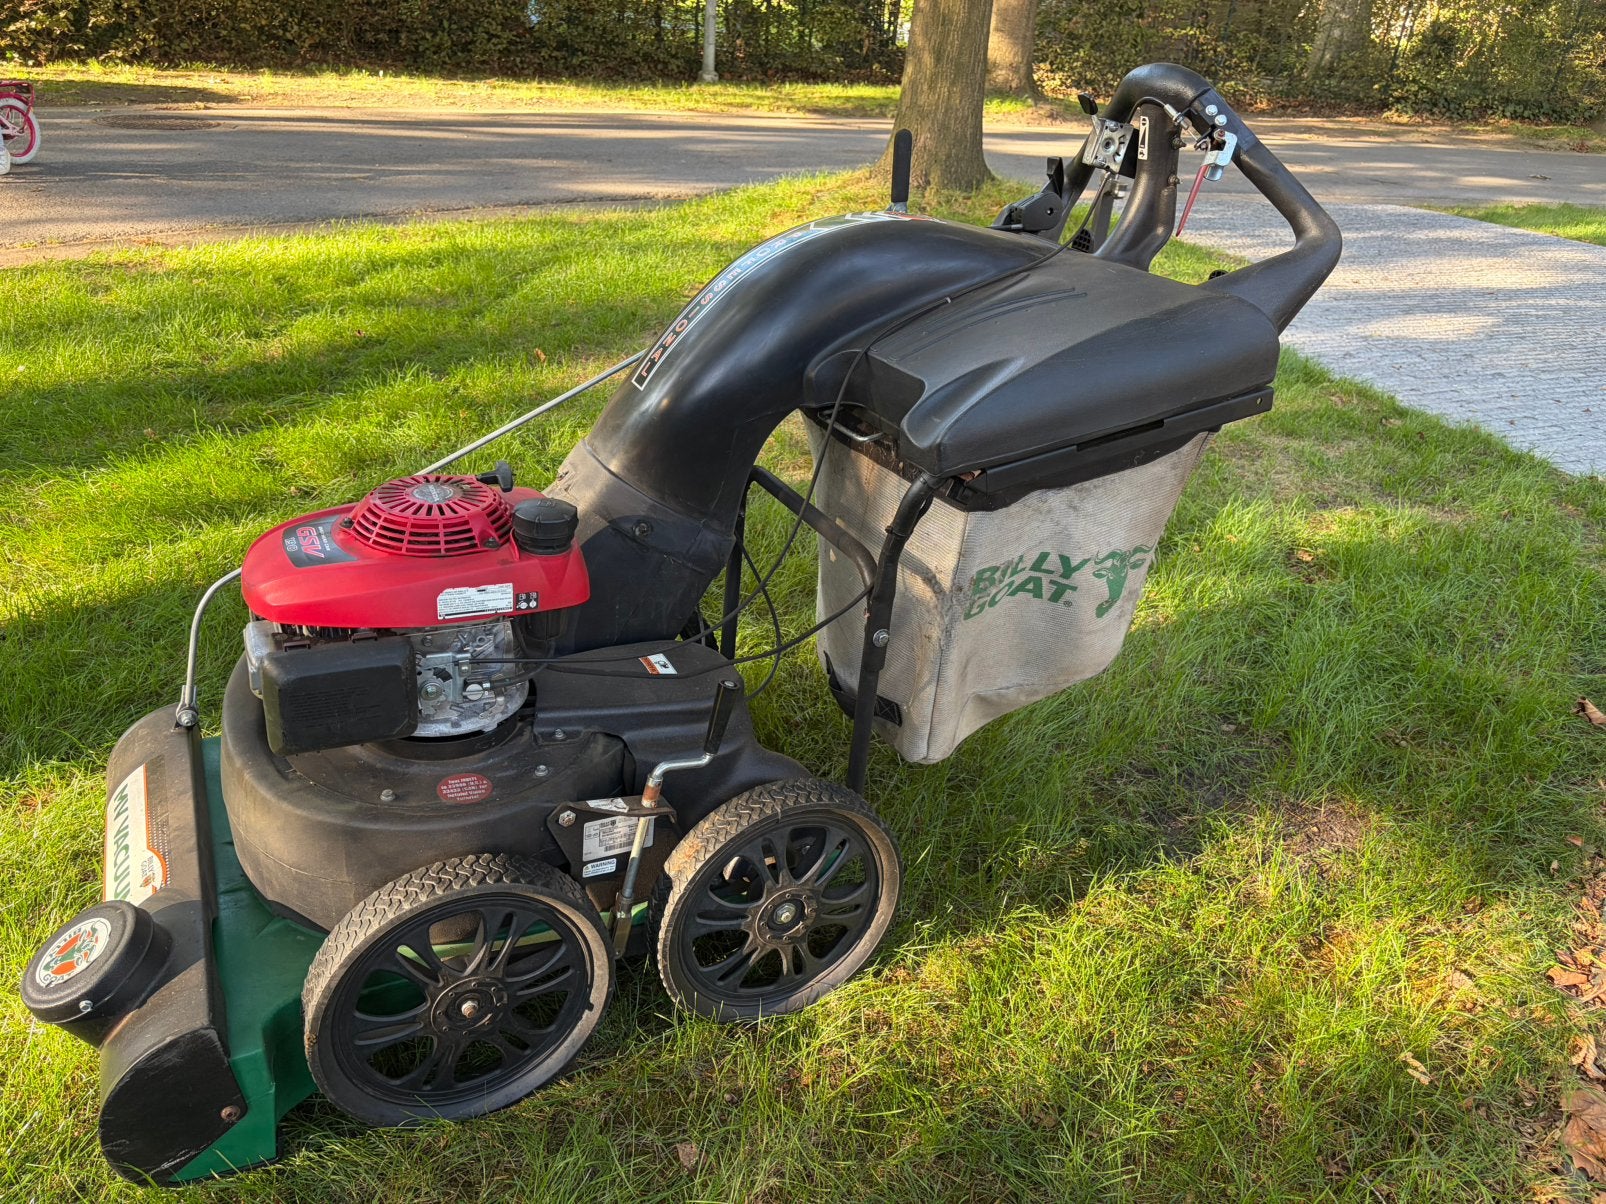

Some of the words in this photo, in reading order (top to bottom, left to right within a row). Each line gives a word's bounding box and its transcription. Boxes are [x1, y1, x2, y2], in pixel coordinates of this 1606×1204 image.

[641, 230, 802, 377] PROFESSIONAL
[296, 526, 325, 558] GSV
[970, 551, 1092, 597] BILLY
[963, 575, 1079, 621] GOAT
[113, 783, 129, 821] MV
